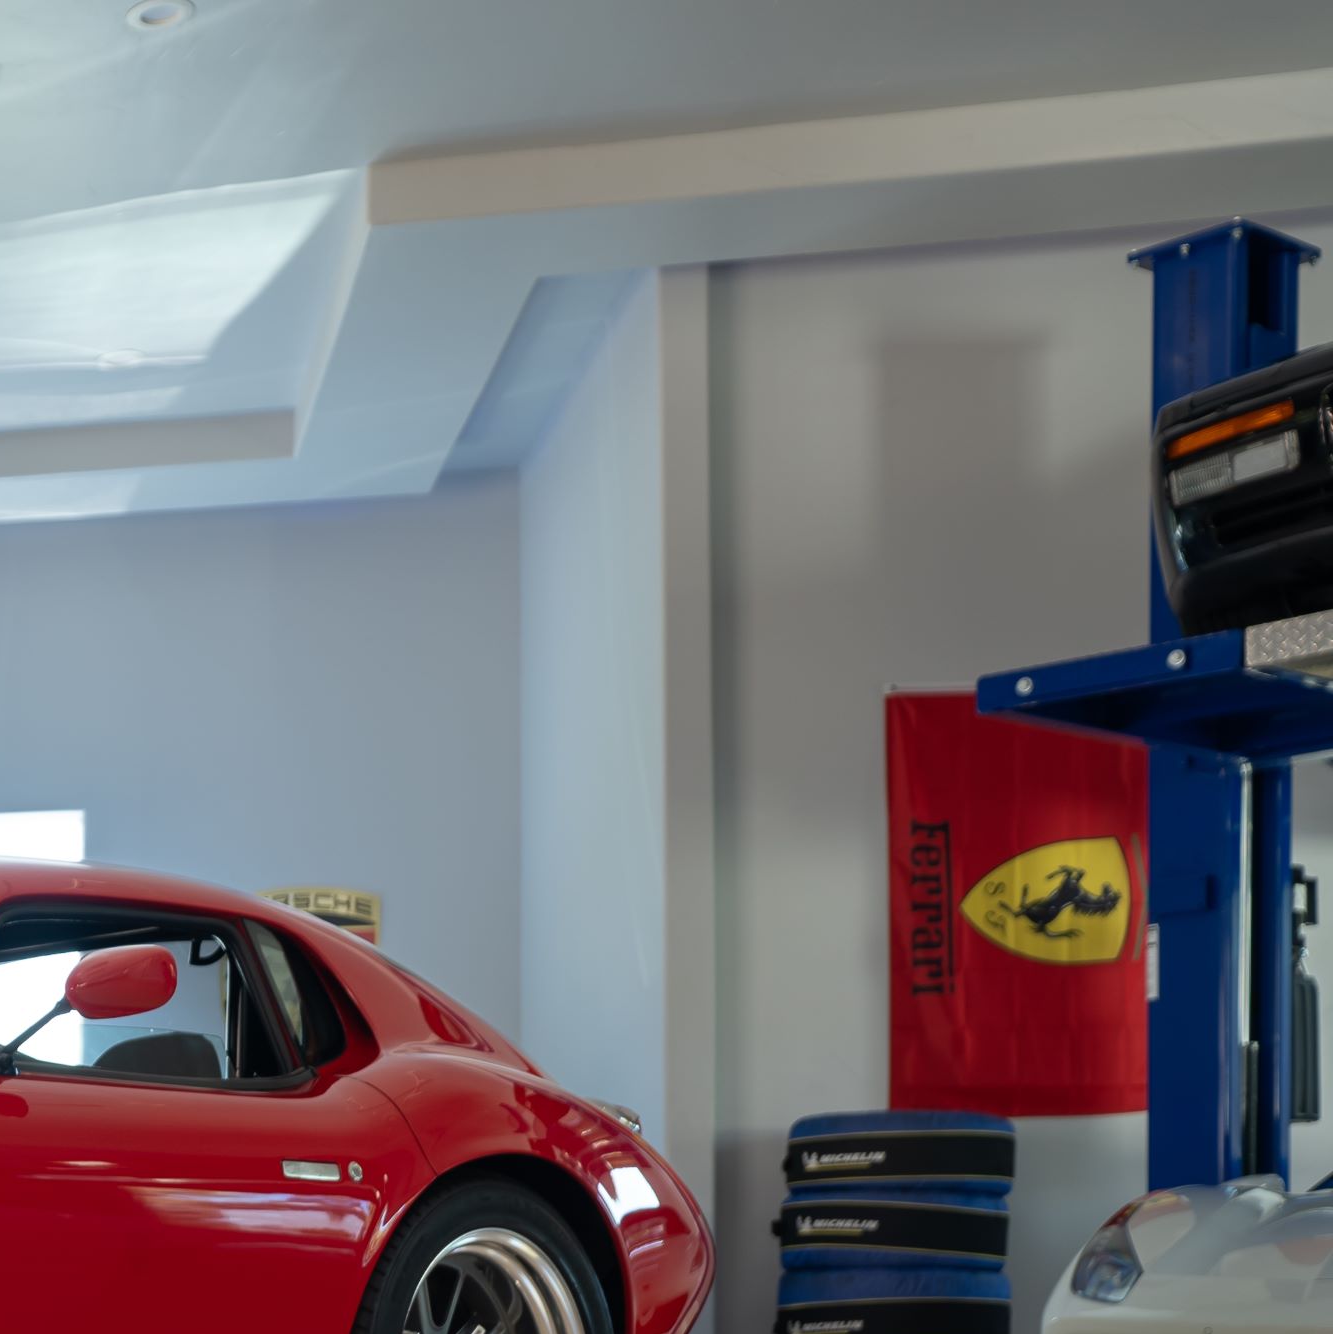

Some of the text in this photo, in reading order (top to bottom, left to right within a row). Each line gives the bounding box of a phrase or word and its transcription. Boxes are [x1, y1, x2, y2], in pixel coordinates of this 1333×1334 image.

[268, 892, 373, 915] RSCHE
[911, 819, 955, 995] Ferrari
[819, 1151, 886, 1163] MICHELIN
[813, 1218, 880, 1231] MICHELIN
[802, 1319, 864, 1331] MICHELIN
